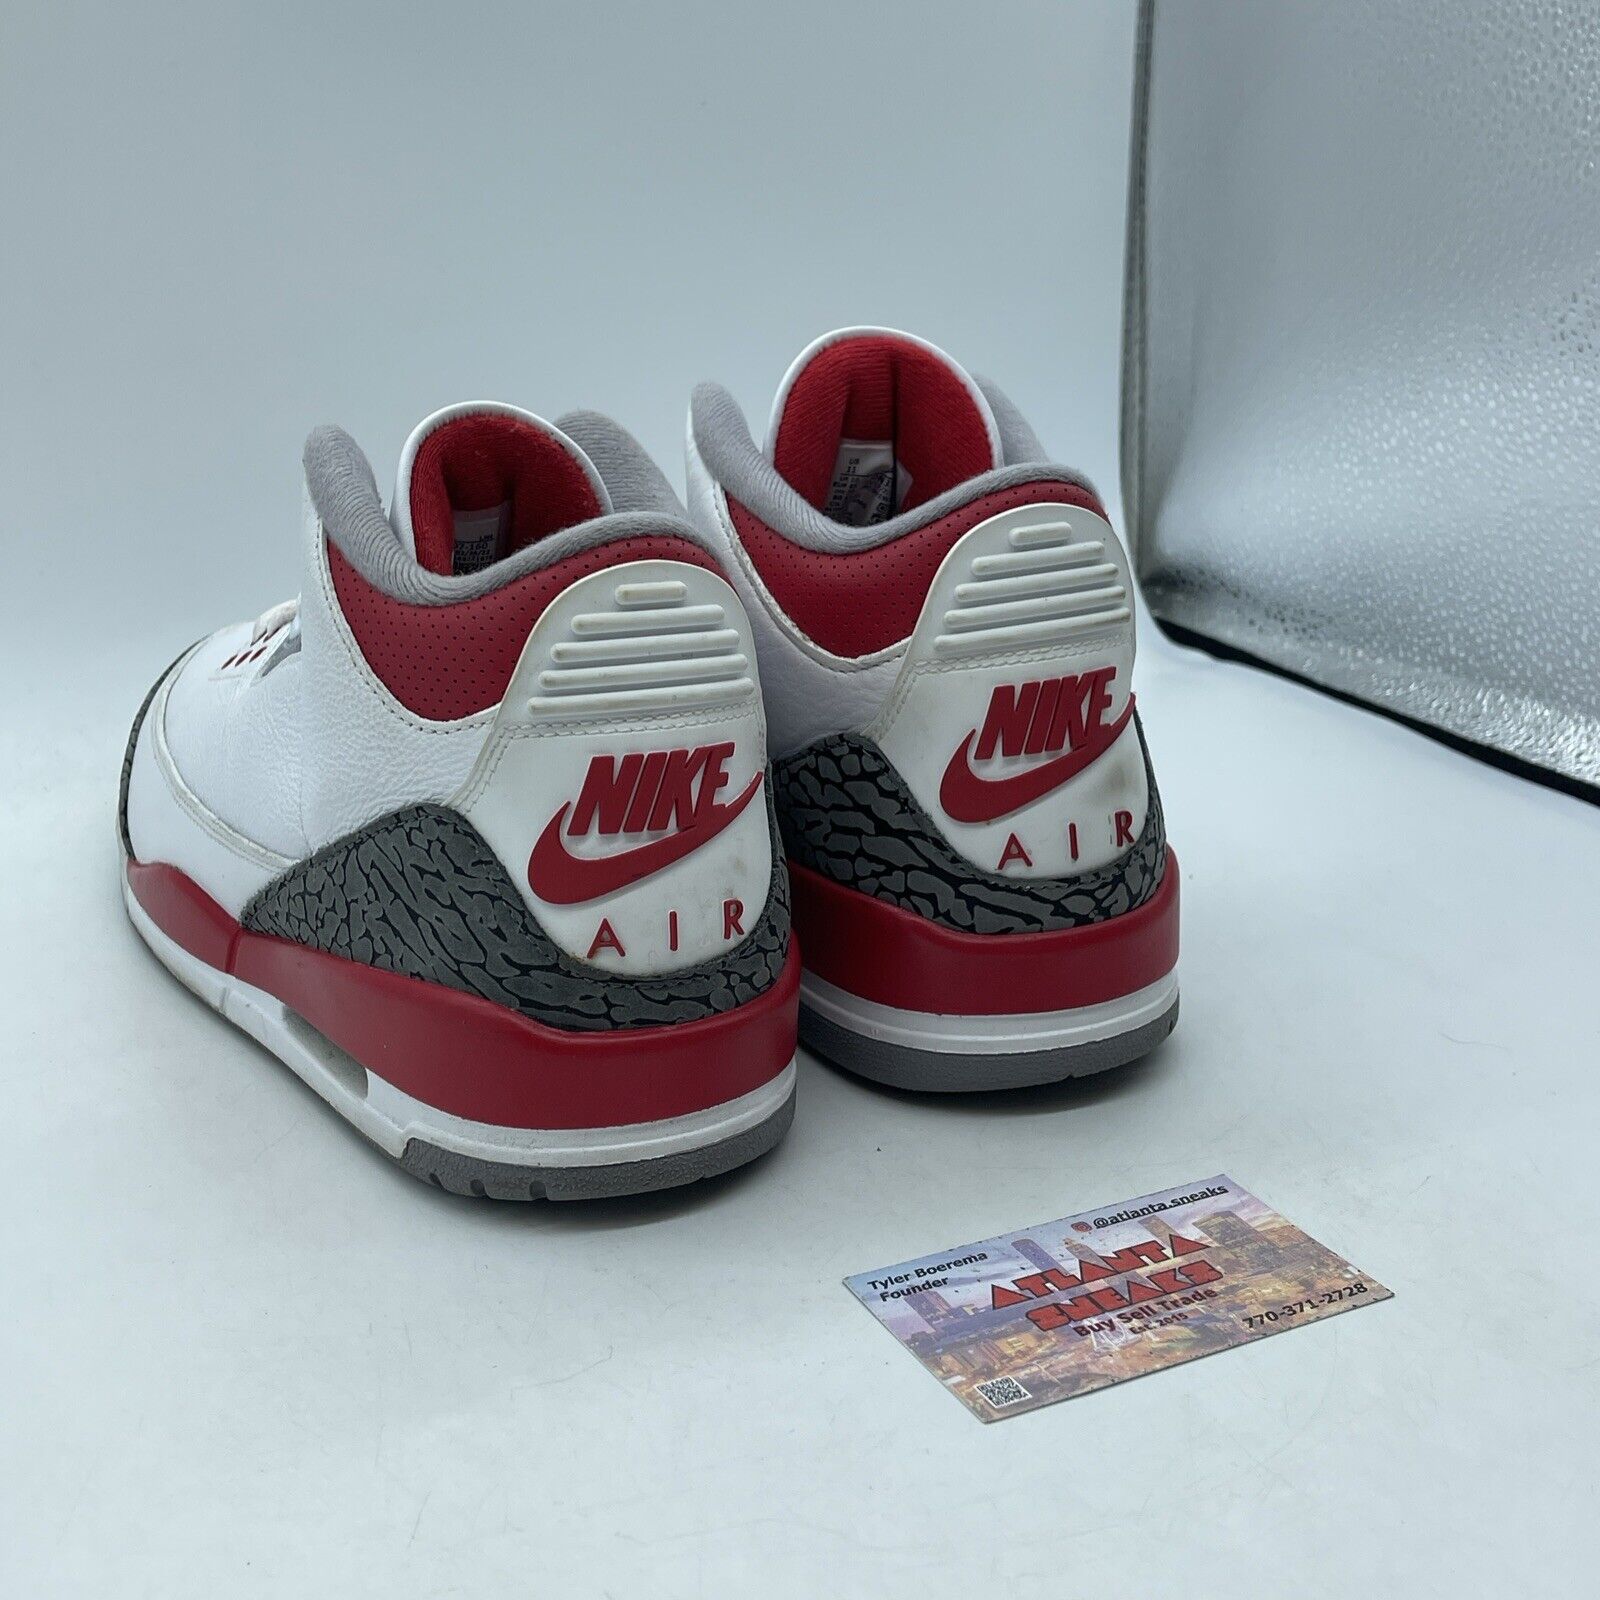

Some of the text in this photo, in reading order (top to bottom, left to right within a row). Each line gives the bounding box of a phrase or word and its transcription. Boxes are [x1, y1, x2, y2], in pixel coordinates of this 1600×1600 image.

[974, 666, 1117, 760] NIKE
[567, 742, 735, 836] NIKE
[998, 811, 1135, 870] AIR
[587, 900, 744, 959] AIR
[1093, 1184, 1229, 1229] @atlanta.sneaks
[867, 1251, 988, 1291] Tyler Boerema
[880, 1276, 950, 1302] Founder
[991, 1233, 1211, 1310] ATLANTA
[1026, 1260, 1224, 1332] SNEAKS
[1073, 1288, 1219, 1337] Buy Sell Trade
[1129, 1312, 1189, 1335] Est. 2015
[1242, 1282, 1368, 1330] 770-371-2728
